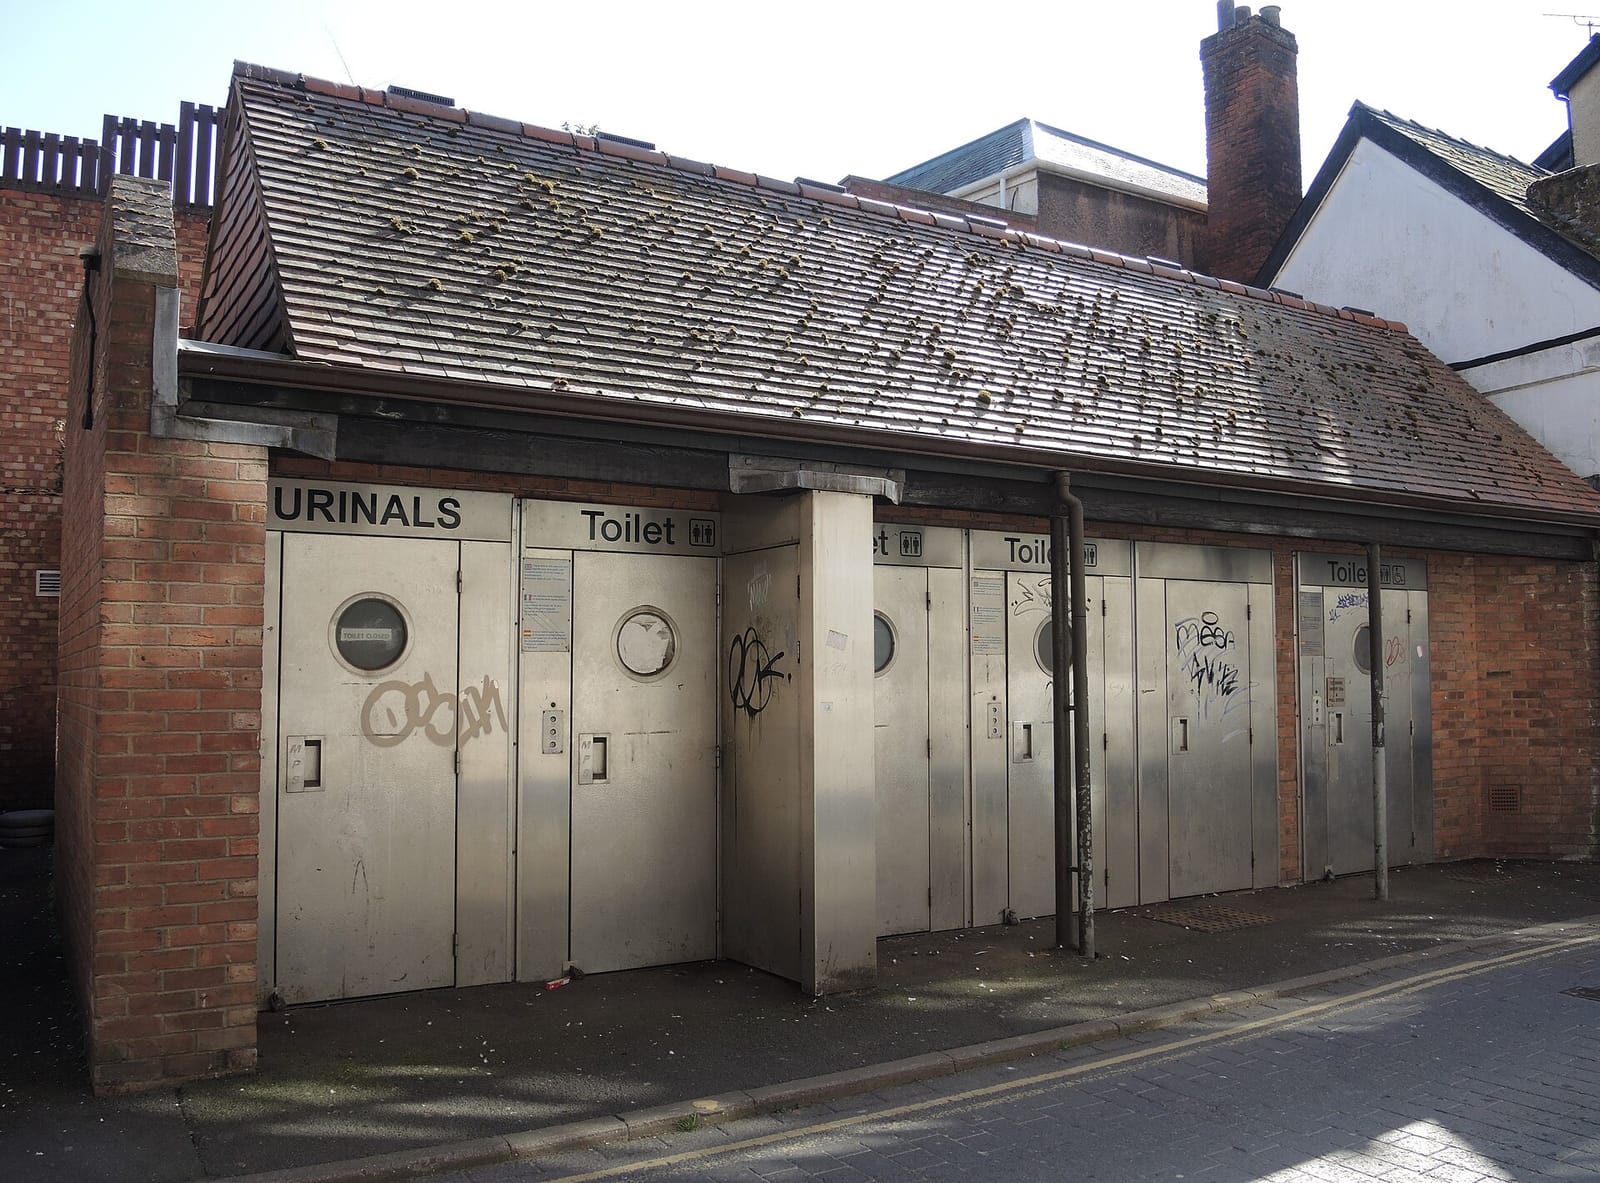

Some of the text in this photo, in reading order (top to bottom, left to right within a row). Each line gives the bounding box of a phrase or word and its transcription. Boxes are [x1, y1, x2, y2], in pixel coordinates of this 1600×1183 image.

[273, 486, 462, 530] URINALS
[580, 509, 676, 546] Toilet
[1004, 537, 1068, 564] Toil
[1327, 561, 1369, 583] Toile
[344, 632, 364, 640] TOILET
